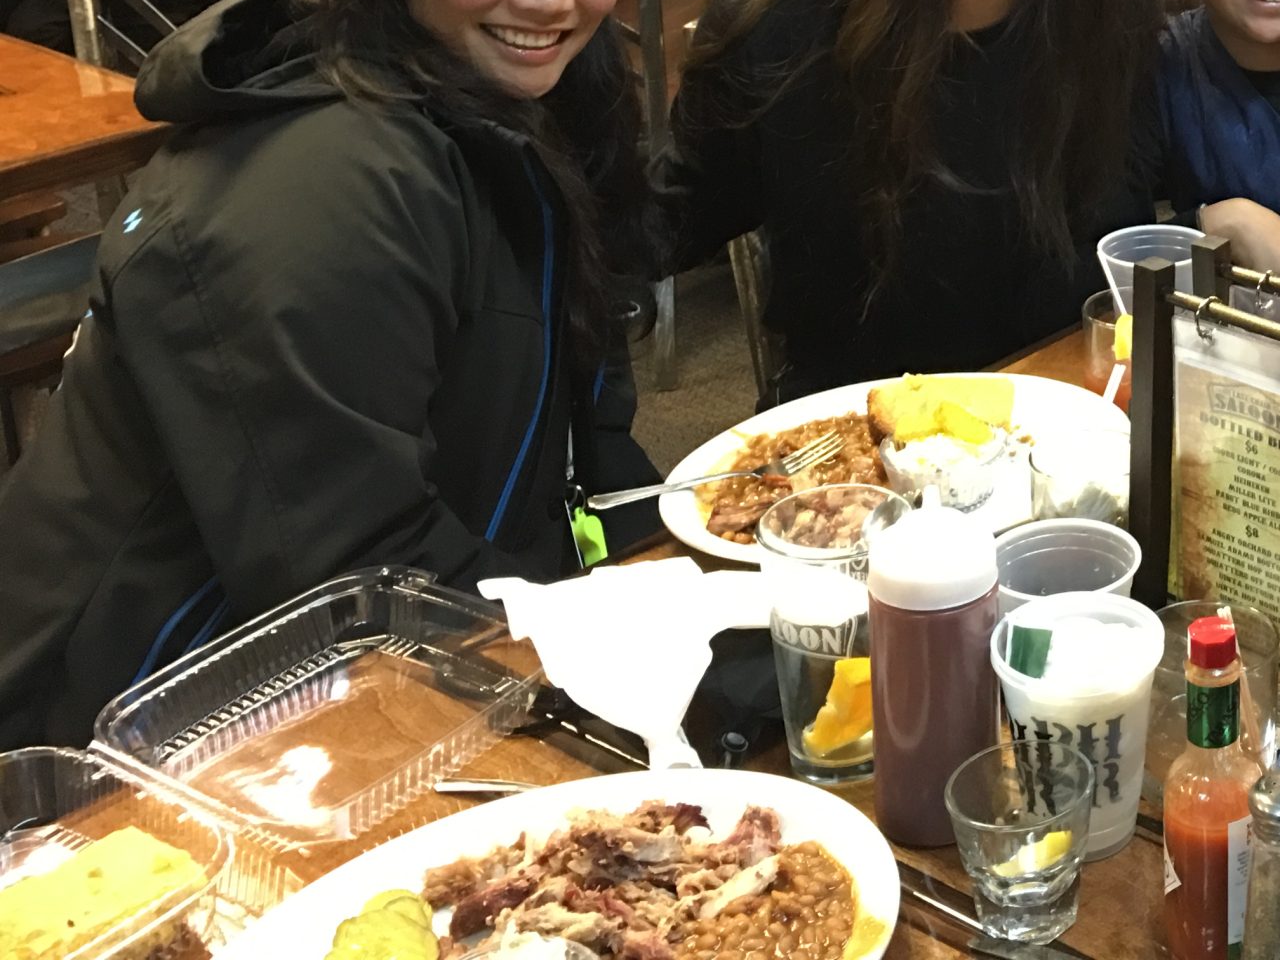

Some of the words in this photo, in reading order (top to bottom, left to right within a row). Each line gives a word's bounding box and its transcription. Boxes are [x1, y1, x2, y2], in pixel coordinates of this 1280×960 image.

[1200, 411, 1263, 442] BOTTLED
[1245, 440, 1258, 455] $6
[1237, 454, 1260, 468] LIGHT
[1237, 466, 1266, 481] CORONA
[1234, 475, 1270, 494] HEINEKEN
[1228, 483, 1256, 499] MILLER
[1259, 494, 1276, 508] LITE
[1242, 499, 1260, 512] BLUE
[1243, 511, 1267, 525] APPLE
[1245, 525, 1259, 538] $8
[1197, 528, 1226, 550] SAMUEL
[1227, 545, 1255, 562] ADAMS
[1212, 528, 1236, 543] ANGRY
[1237, 538, 1272, 558] ORCHARD
